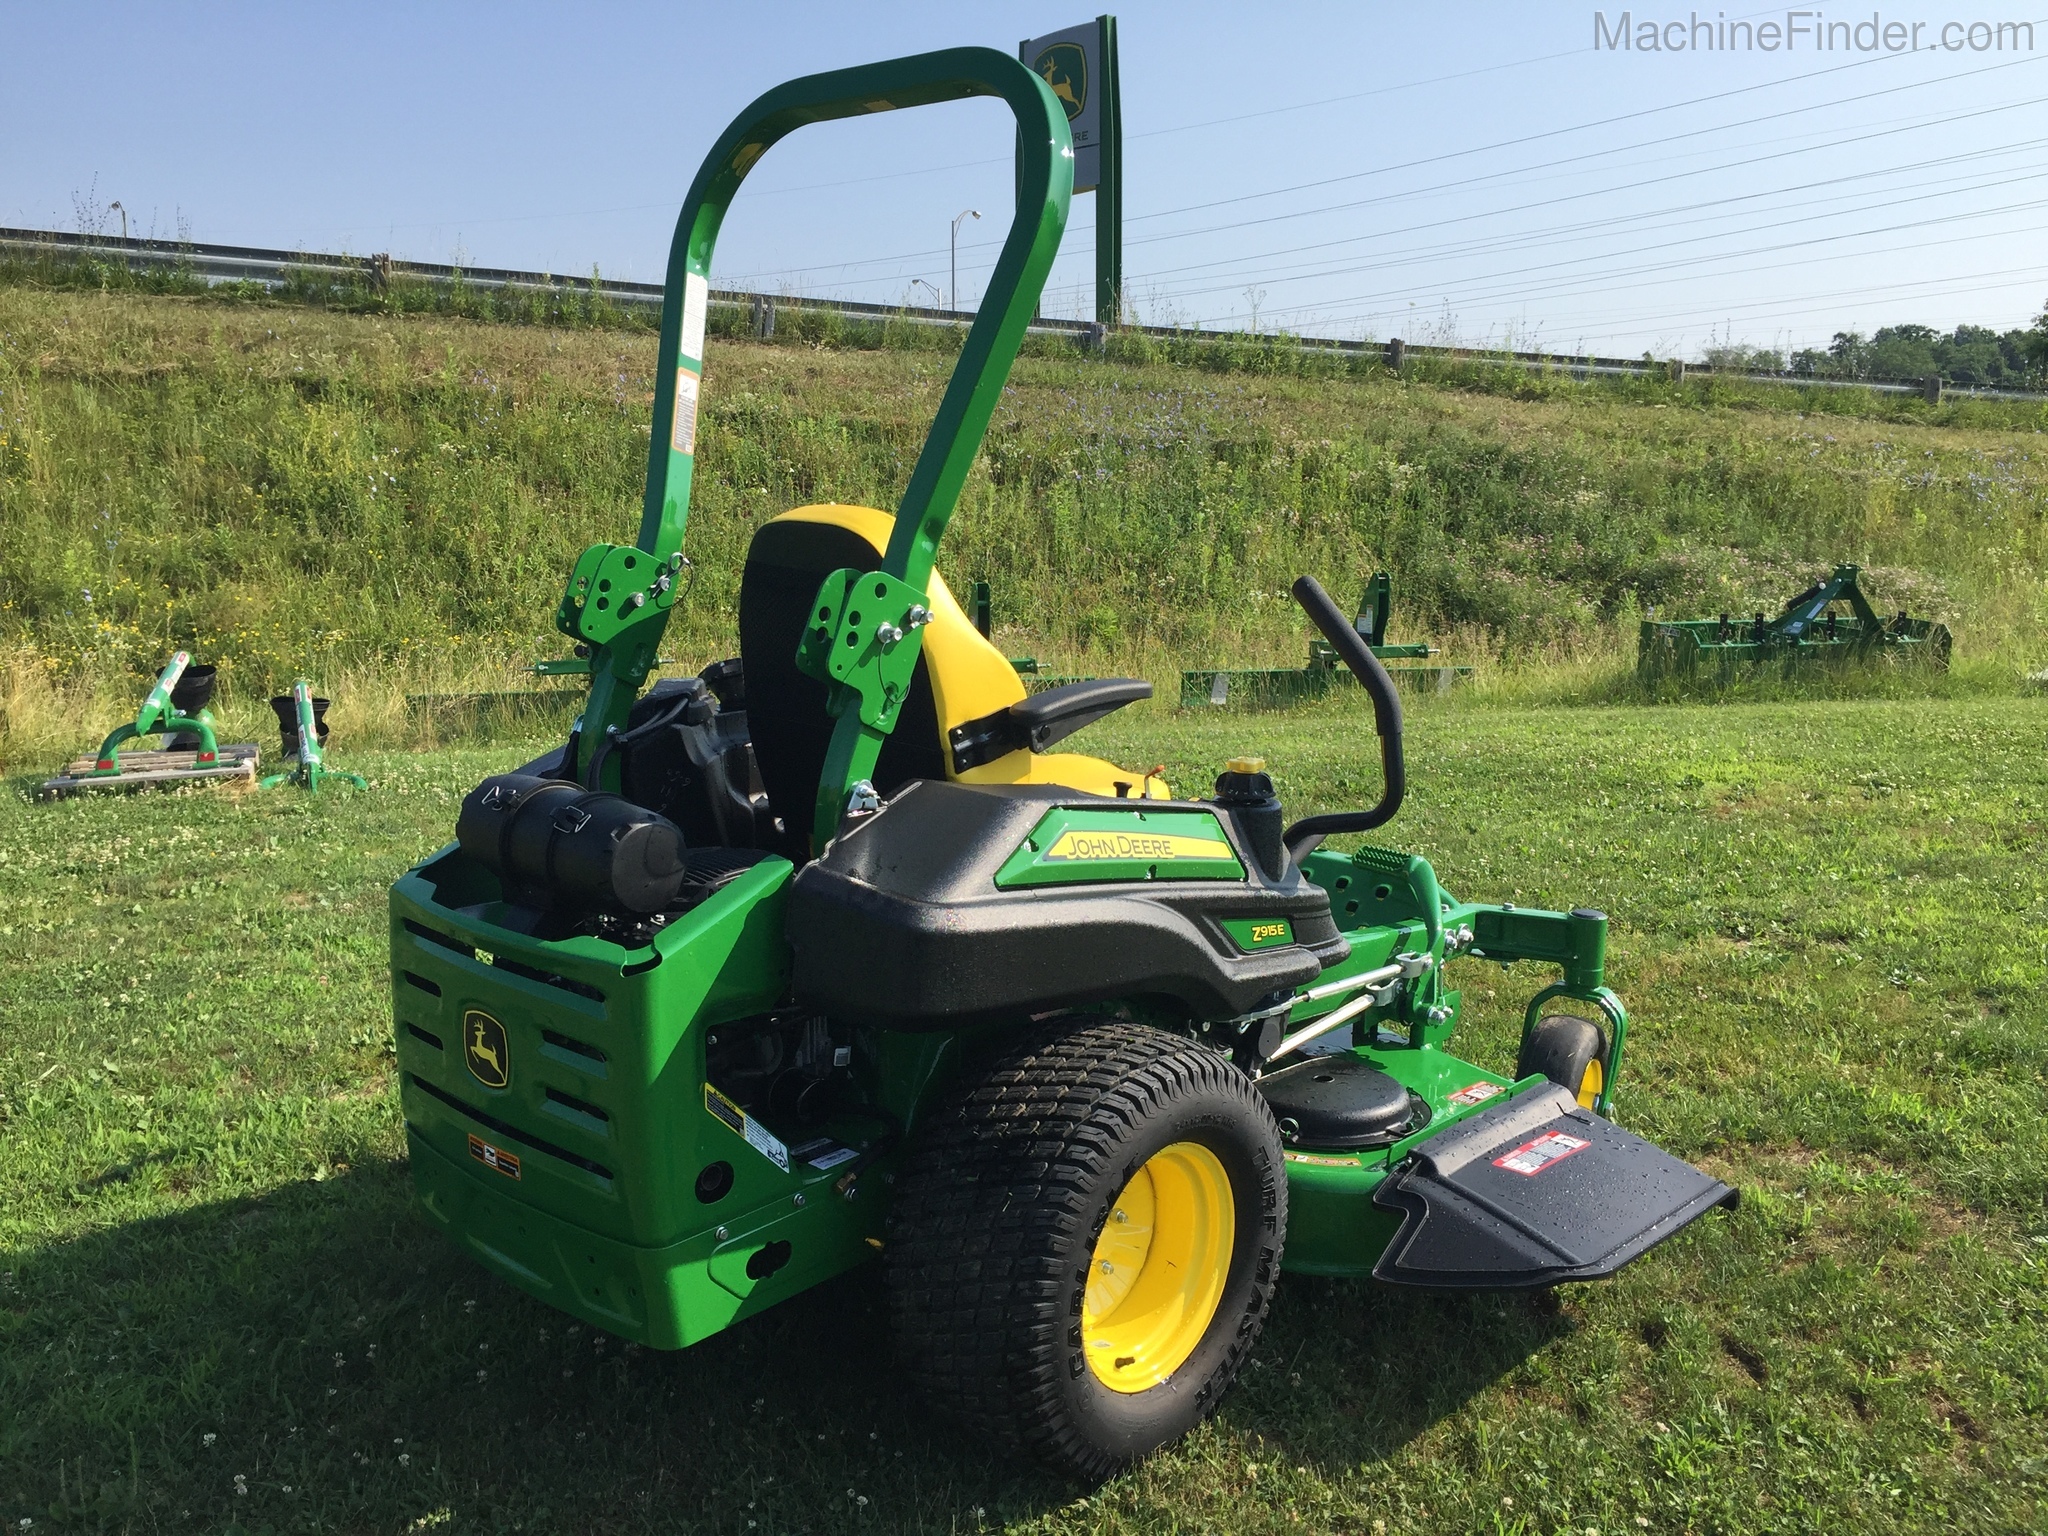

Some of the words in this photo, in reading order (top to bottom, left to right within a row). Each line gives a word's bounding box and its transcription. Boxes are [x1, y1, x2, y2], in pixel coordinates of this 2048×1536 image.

[1067, 835, 1116, 857] JOHN
[1119, 835, 1174, 856] DEERE
[1251, 923, 1285, 942] Z915E
[1252, 1146, 1277, 1237] TURF
[1194, 1245, 1275, 1412] MASTER
